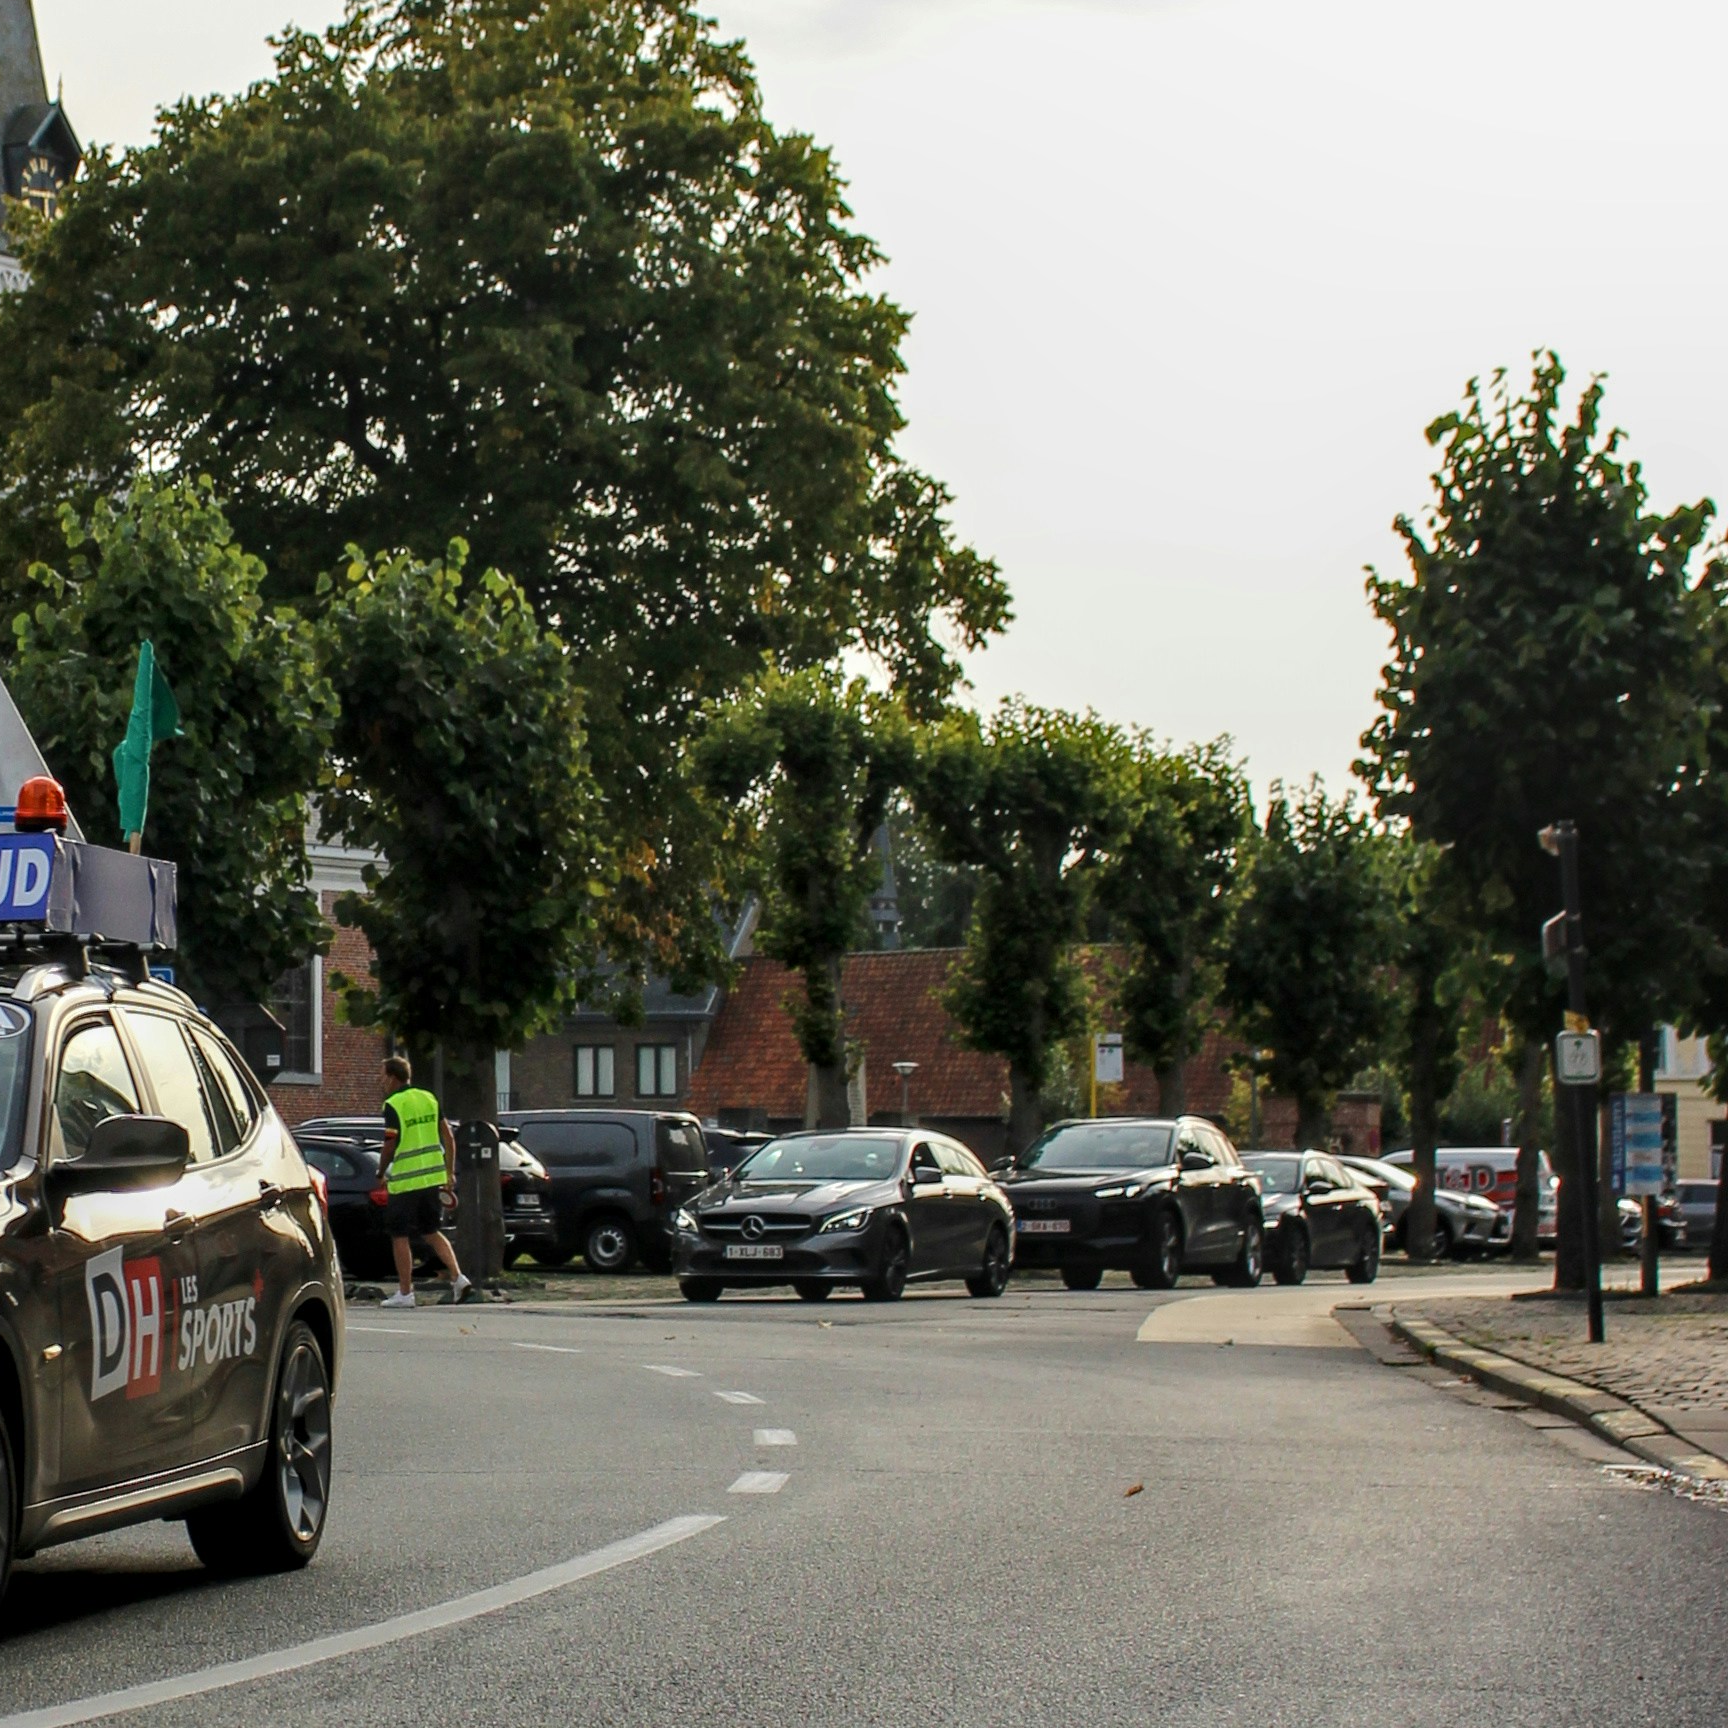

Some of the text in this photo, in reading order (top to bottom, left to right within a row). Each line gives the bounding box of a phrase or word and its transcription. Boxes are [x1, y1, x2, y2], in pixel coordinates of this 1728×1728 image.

[92, 1272, 161, 1380] DH
[181, 1275, 198, 1304] LES
[178, 1297, 256, 1371] SPORTS
